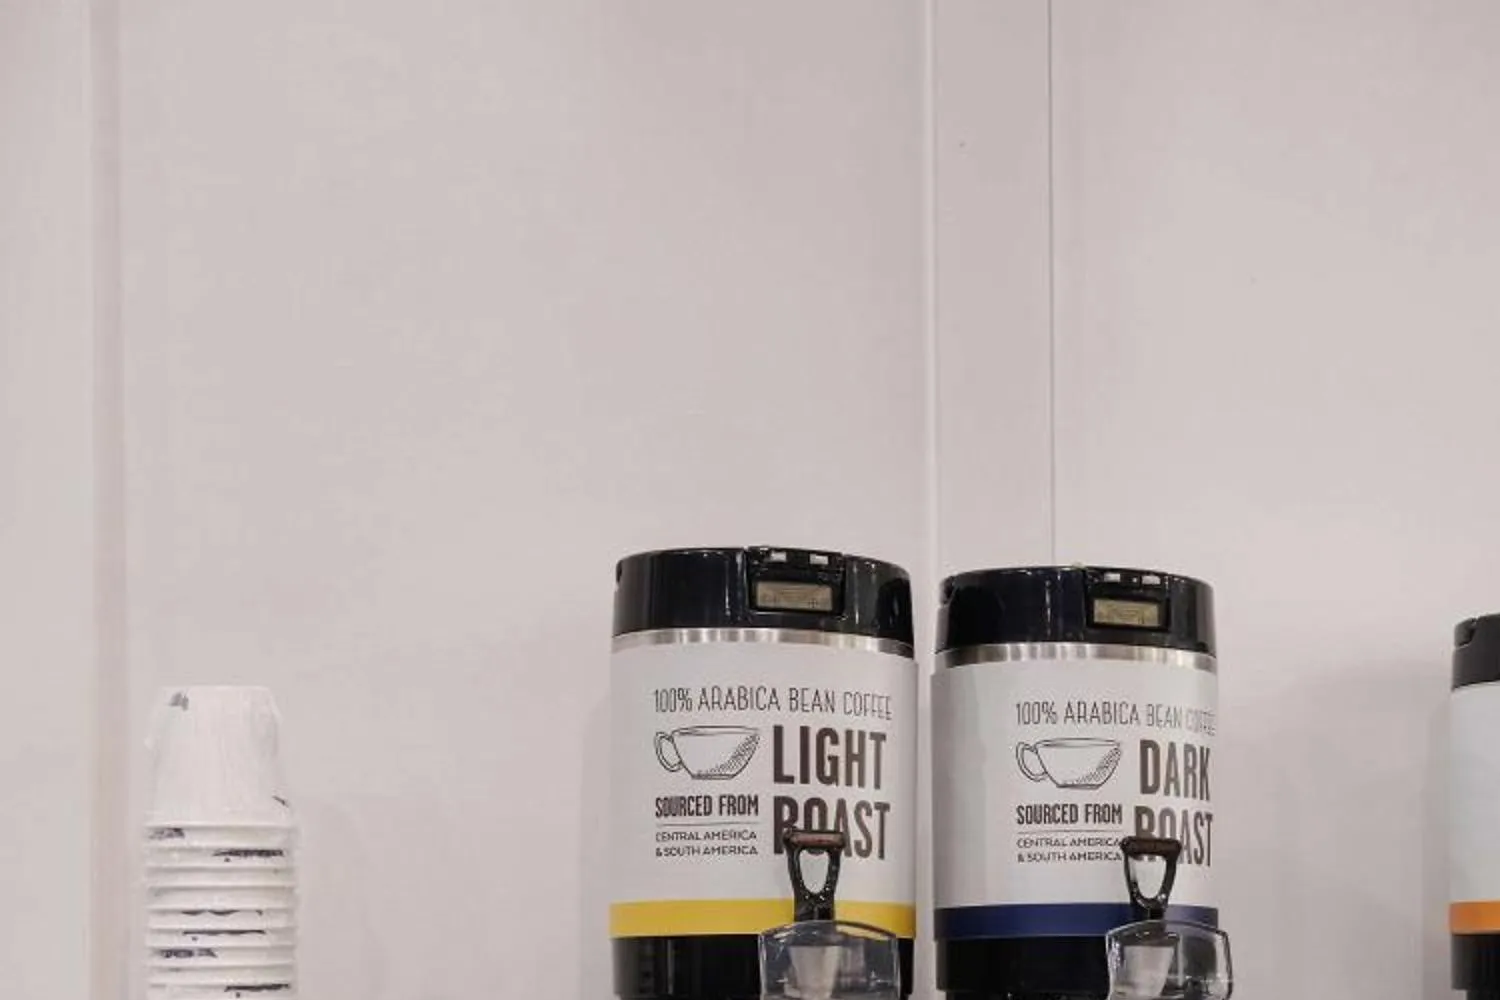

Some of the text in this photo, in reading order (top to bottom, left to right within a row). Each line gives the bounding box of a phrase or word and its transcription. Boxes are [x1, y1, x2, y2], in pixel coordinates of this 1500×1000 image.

[653, 685, 893, 721] 100% ARABICA BEAN COFFEE
[1016, 701, 1057, 726] 100%
[1063, 700, 1141, 725] ARABICA
[1147, 703, 1183, 730] BEAN
[773, 724, 887, 790] LIGHT
[1139, 739, 1211, 801] DARK
[655, 794, 759, 818] SOURCED FROM
[1016, 803, 1123, 825] SOURCED FROM
[656, 829, 757, 843] CENTRAL AMERICA
[773, 795, 891, 861] ROAST
[1134, 805, 1214, 867] ROAST
[703, 845, 758, 857] AMERICA
[1016, 837, 1122, 849] CENTRAL AMERICA
[1069, 851, 1123, 862] AMERICA
